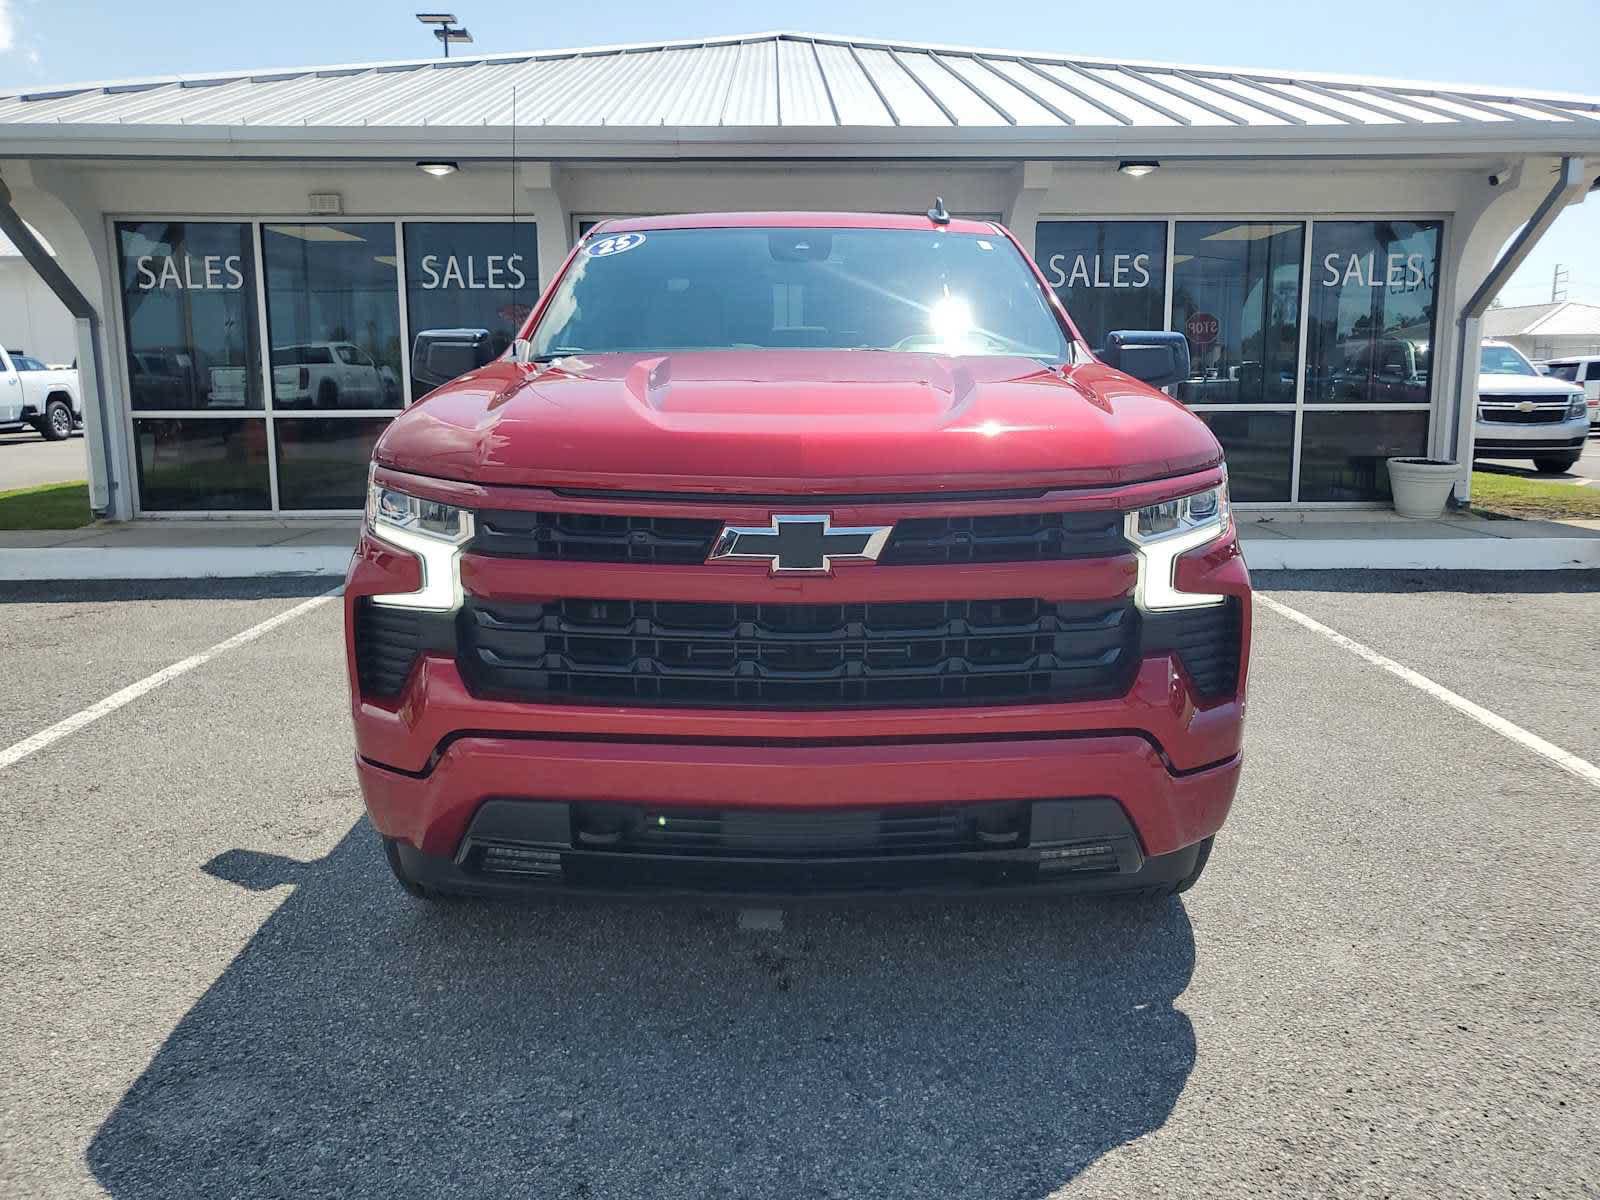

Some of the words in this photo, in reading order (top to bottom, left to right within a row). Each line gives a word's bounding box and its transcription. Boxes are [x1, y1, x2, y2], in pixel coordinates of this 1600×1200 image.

[598, 235, 631, 255] 25
[137, 255, 244, 289] SALES
[421, 255, 526, 289] SALES
[1048, 254, 1150, 288] SALES
[1322, 253, 1424, 287] SALES
